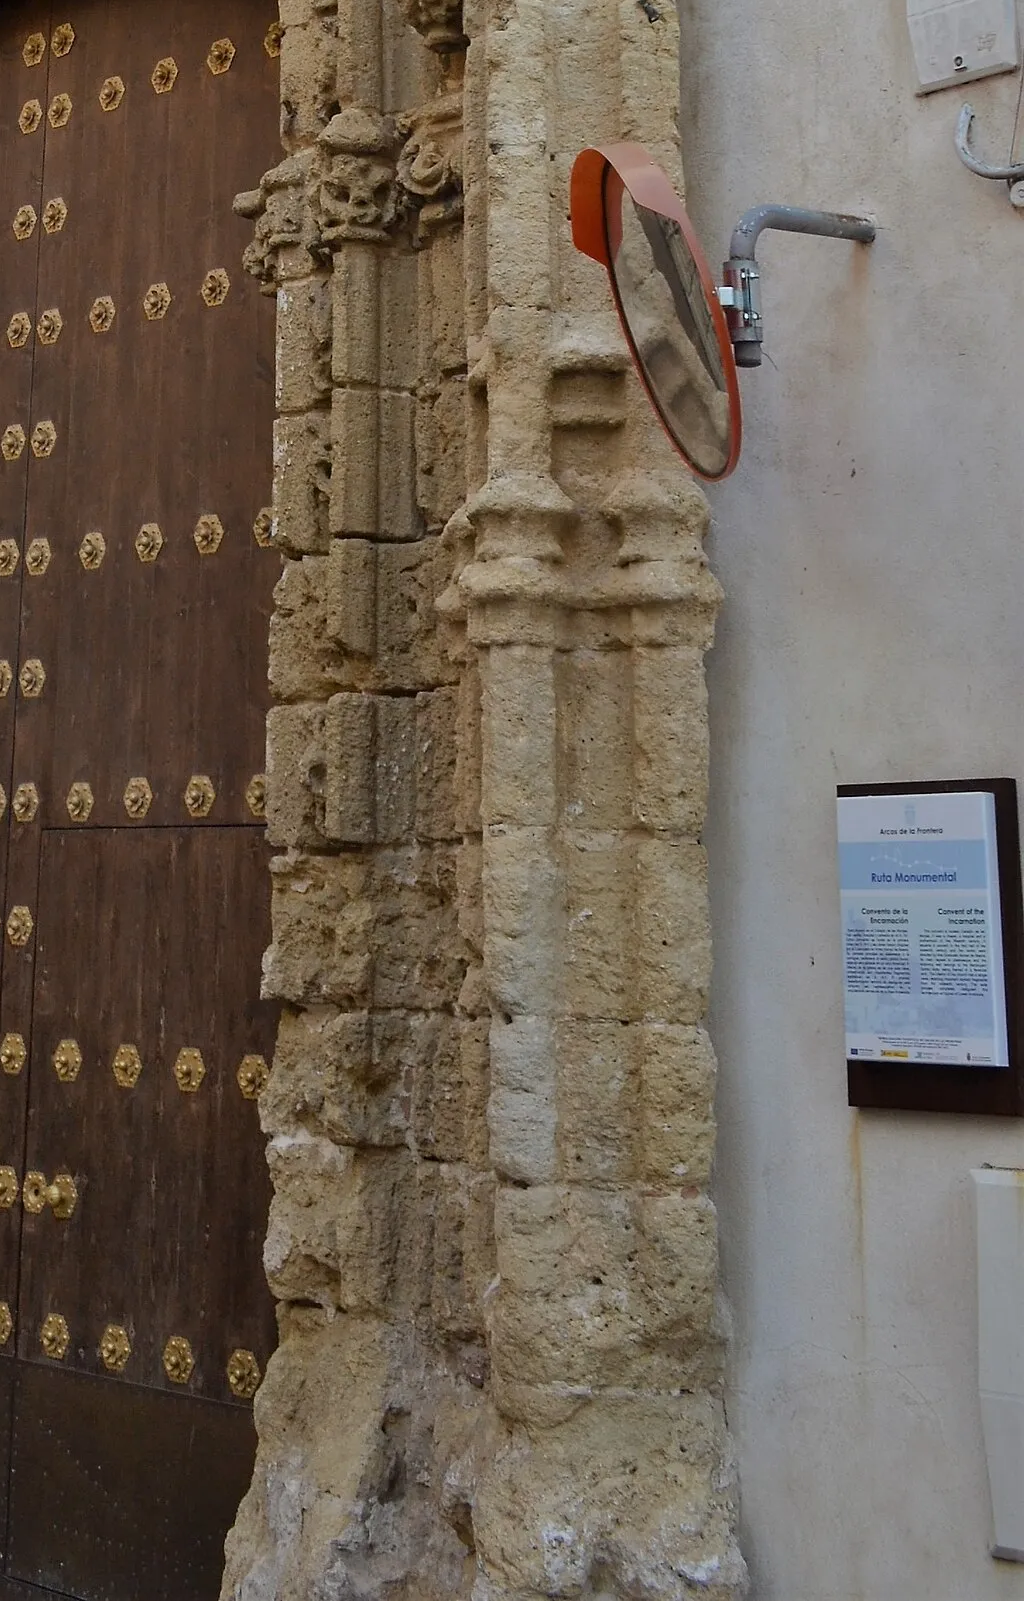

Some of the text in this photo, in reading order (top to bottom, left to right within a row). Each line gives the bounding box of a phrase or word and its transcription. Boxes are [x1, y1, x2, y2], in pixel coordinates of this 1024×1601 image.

[871, 871, 957, 882] Ruta Monumental
[870, 916, 909, 924] Encarnación
